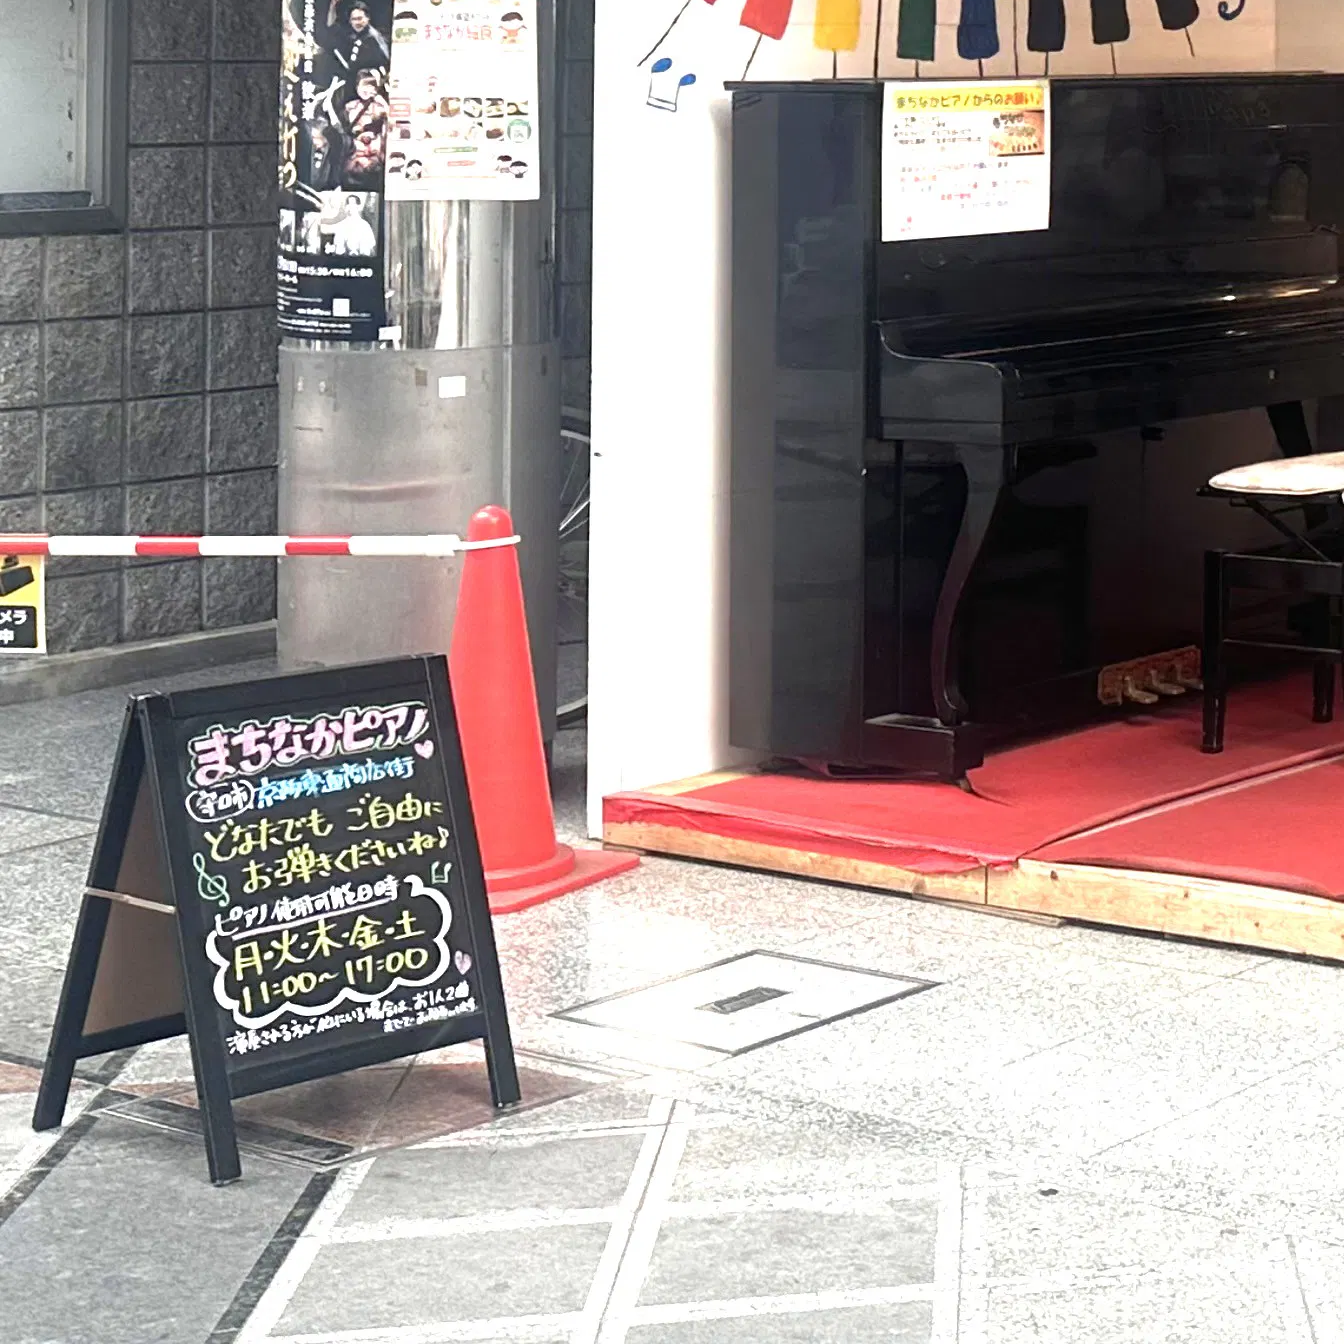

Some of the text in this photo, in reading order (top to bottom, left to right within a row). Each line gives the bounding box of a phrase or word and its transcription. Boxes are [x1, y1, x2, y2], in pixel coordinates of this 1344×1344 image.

[194, 706, 429, 787] まちなかピアノ
[204, 792, 444, 862] どなたでも ご自由に
